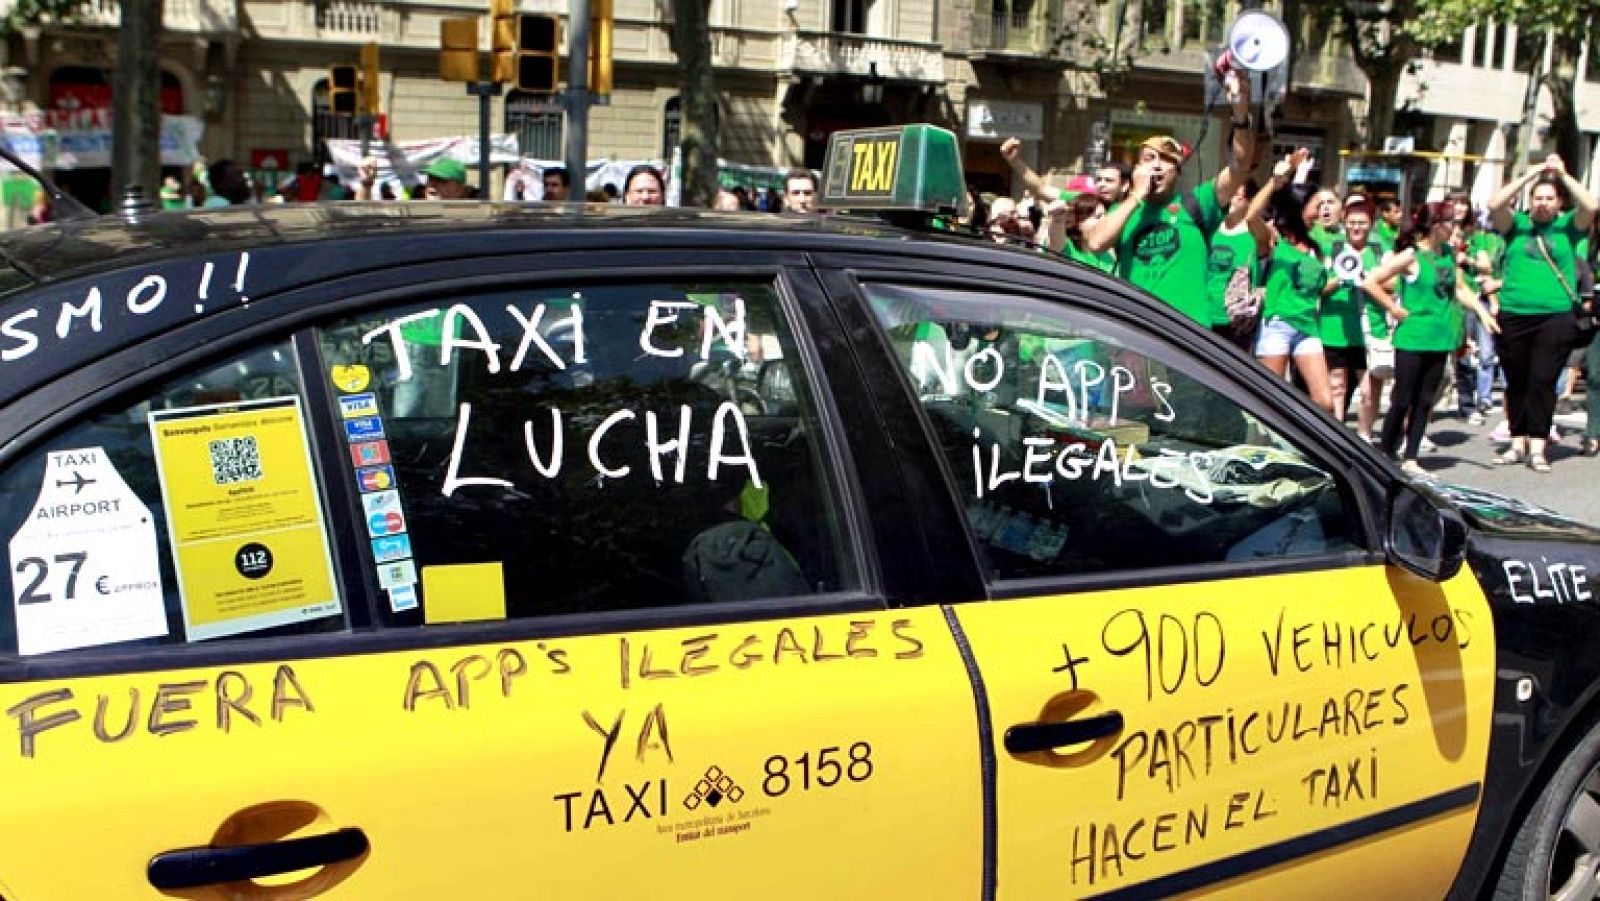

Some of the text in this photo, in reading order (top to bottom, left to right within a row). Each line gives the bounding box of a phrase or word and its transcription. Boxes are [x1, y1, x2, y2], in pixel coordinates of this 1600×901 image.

[851, 141, 897, 190] TAXI
[638, 298, 747, 364] EN
[911, 338, 1004, 397] NO
[53, 452, 97, 468] TAXI
[442, 401, 763, 497] LUCHA
[15, 551, 88, 606] 27
[95, 575, 111, 595] €
[240, 550, 268, 567] 112
[6, 663, 315, 759] FUERA
[620, 618, 925, 690] ILEGALES
[1101, 608, 1226, 701] 900
[1261, 607, 1474, 677] VEHICULOS
[581, 702, 675, 781] YA
[553, 741, 875, 833] TAXI 8158
[1070, 803, 1210, 886] HACEN
[1224, 788, 1278, 831] EL
